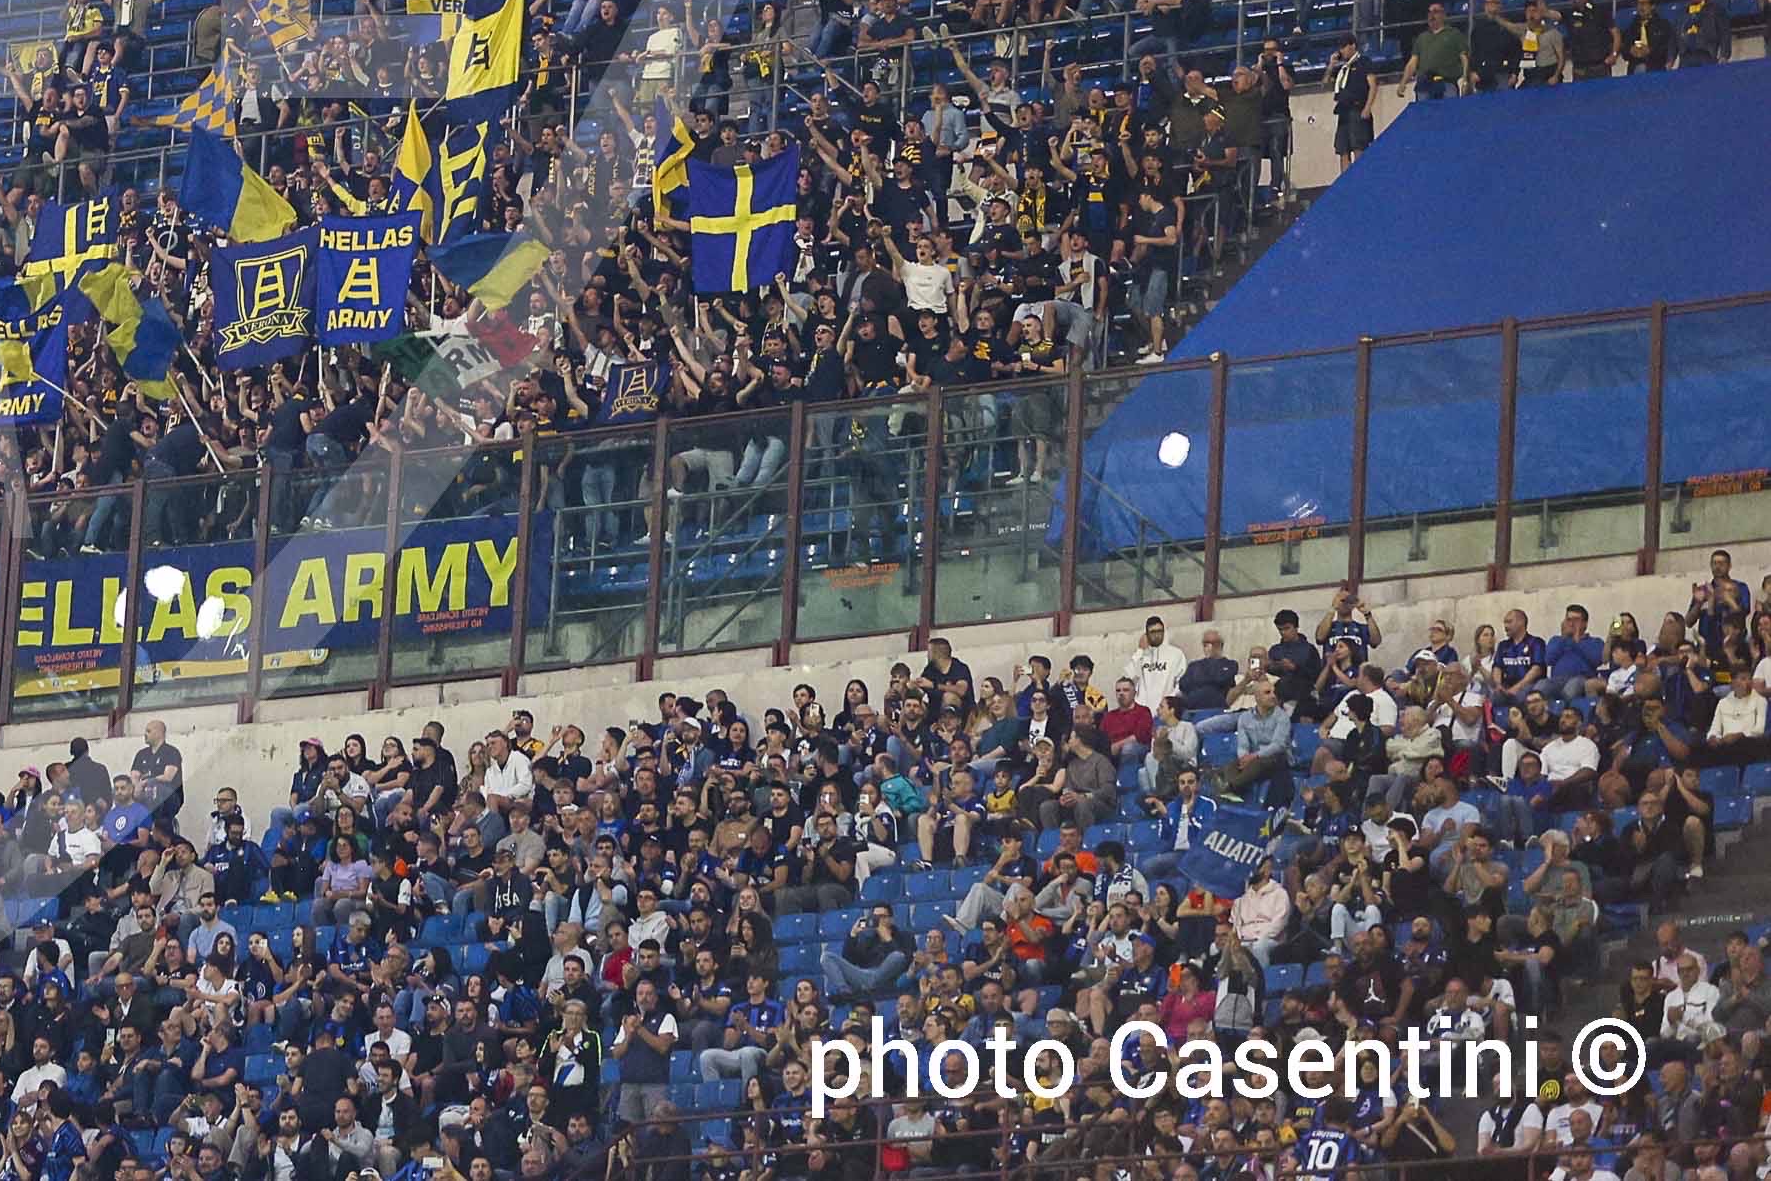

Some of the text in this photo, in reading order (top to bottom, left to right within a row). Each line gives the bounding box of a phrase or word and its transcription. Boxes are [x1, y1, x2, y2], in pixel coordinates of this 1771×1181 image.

[319, 226, 414, 252] HELLAS
[243, 313, 289, 334] VERONA
[327, 308, 394, 331] ARMY
[278, 536, 519, 628] ARMY
[1307, 1138, 1339, 1170] 10
